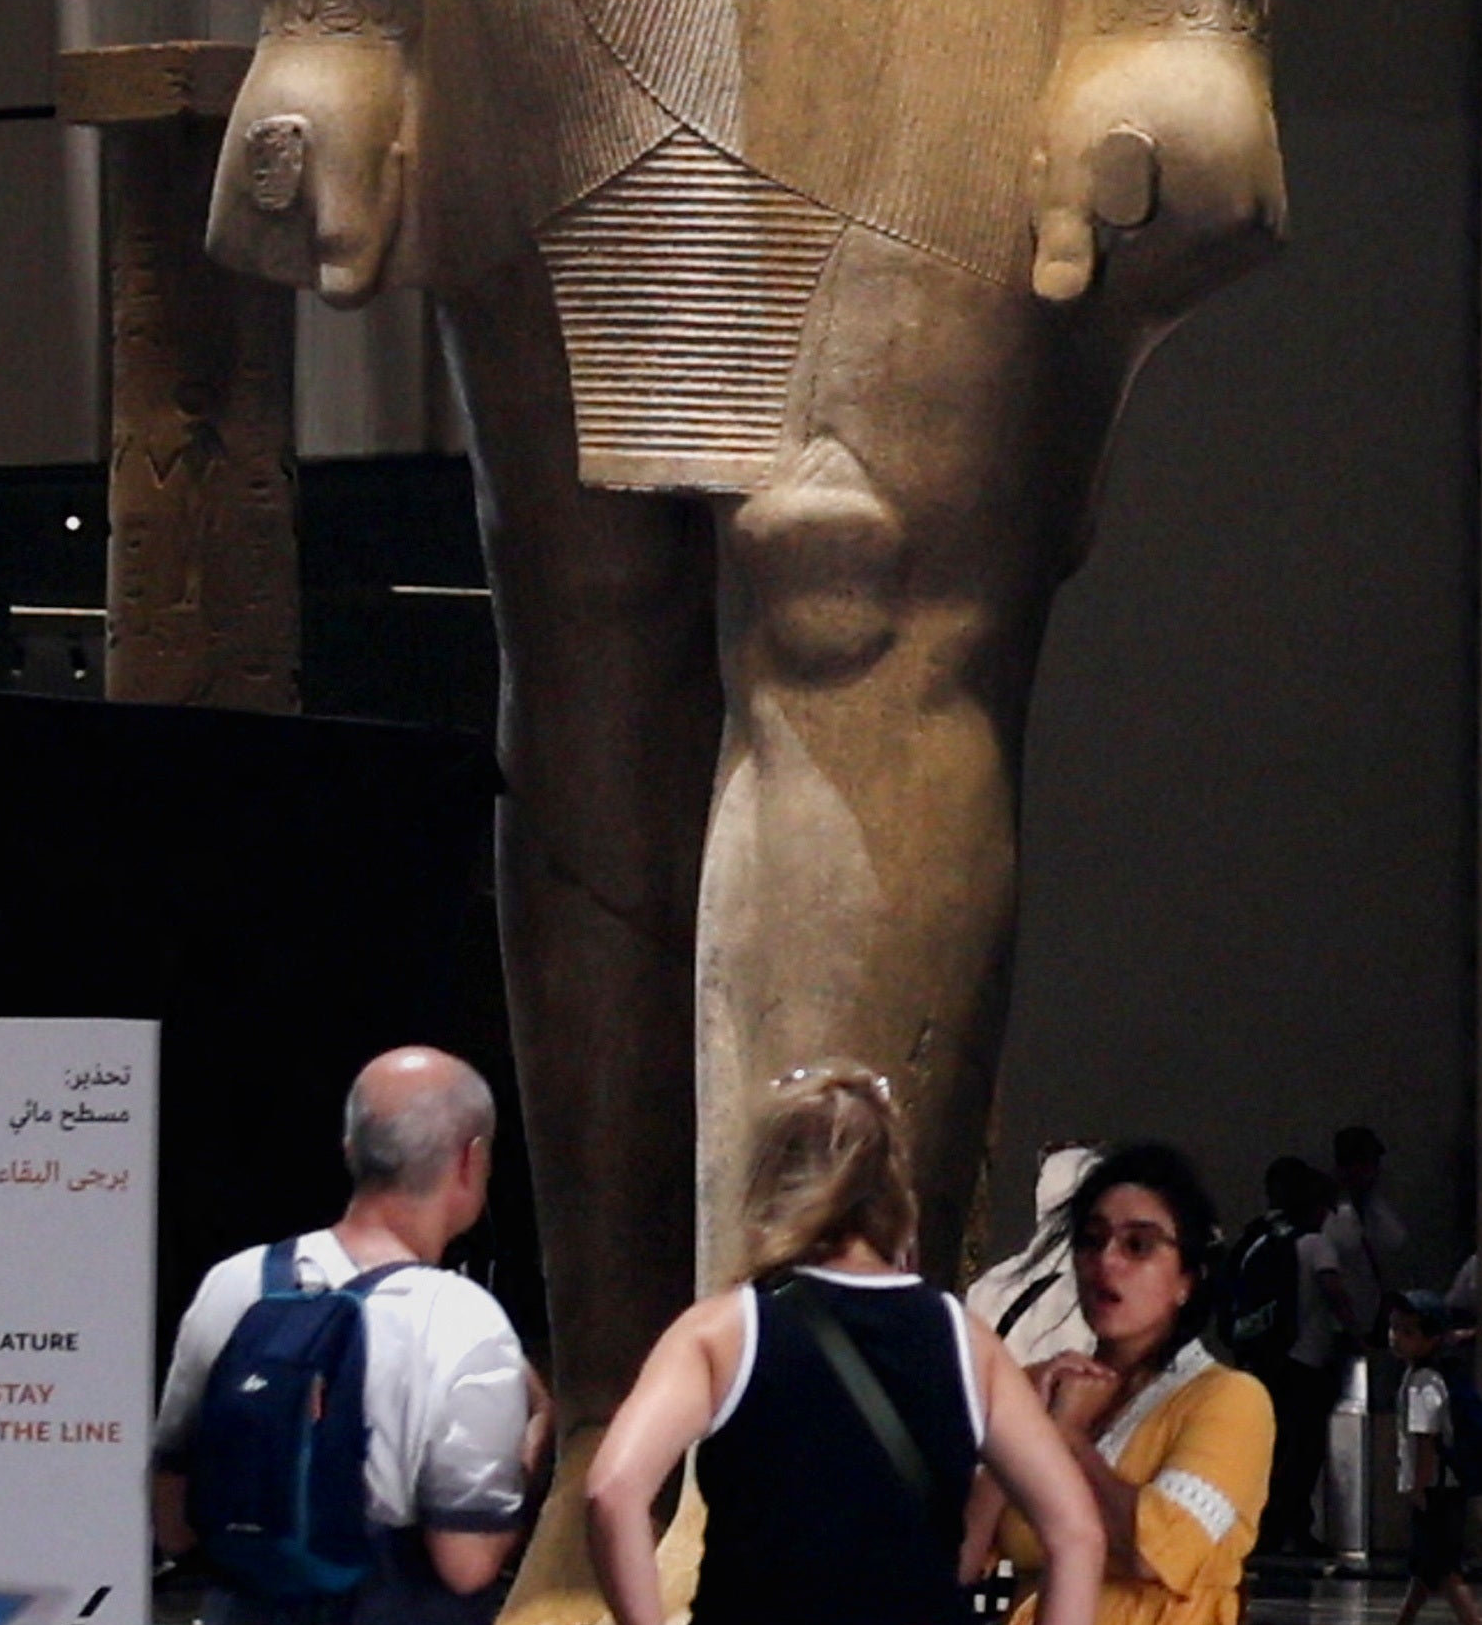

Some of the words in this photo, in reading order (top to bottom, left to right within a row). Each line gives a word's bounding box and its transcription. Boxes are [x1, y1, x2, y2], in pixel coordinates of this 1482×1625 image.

[65, 1063, 132, 1090] تحذير:
[8, 1099, 53, 1135] مائي
[59, 1102, 130, 1131] مسطح
[67, 1167, 130, 1192] يرجى
[60, 1421, 122, 1443] LINE
